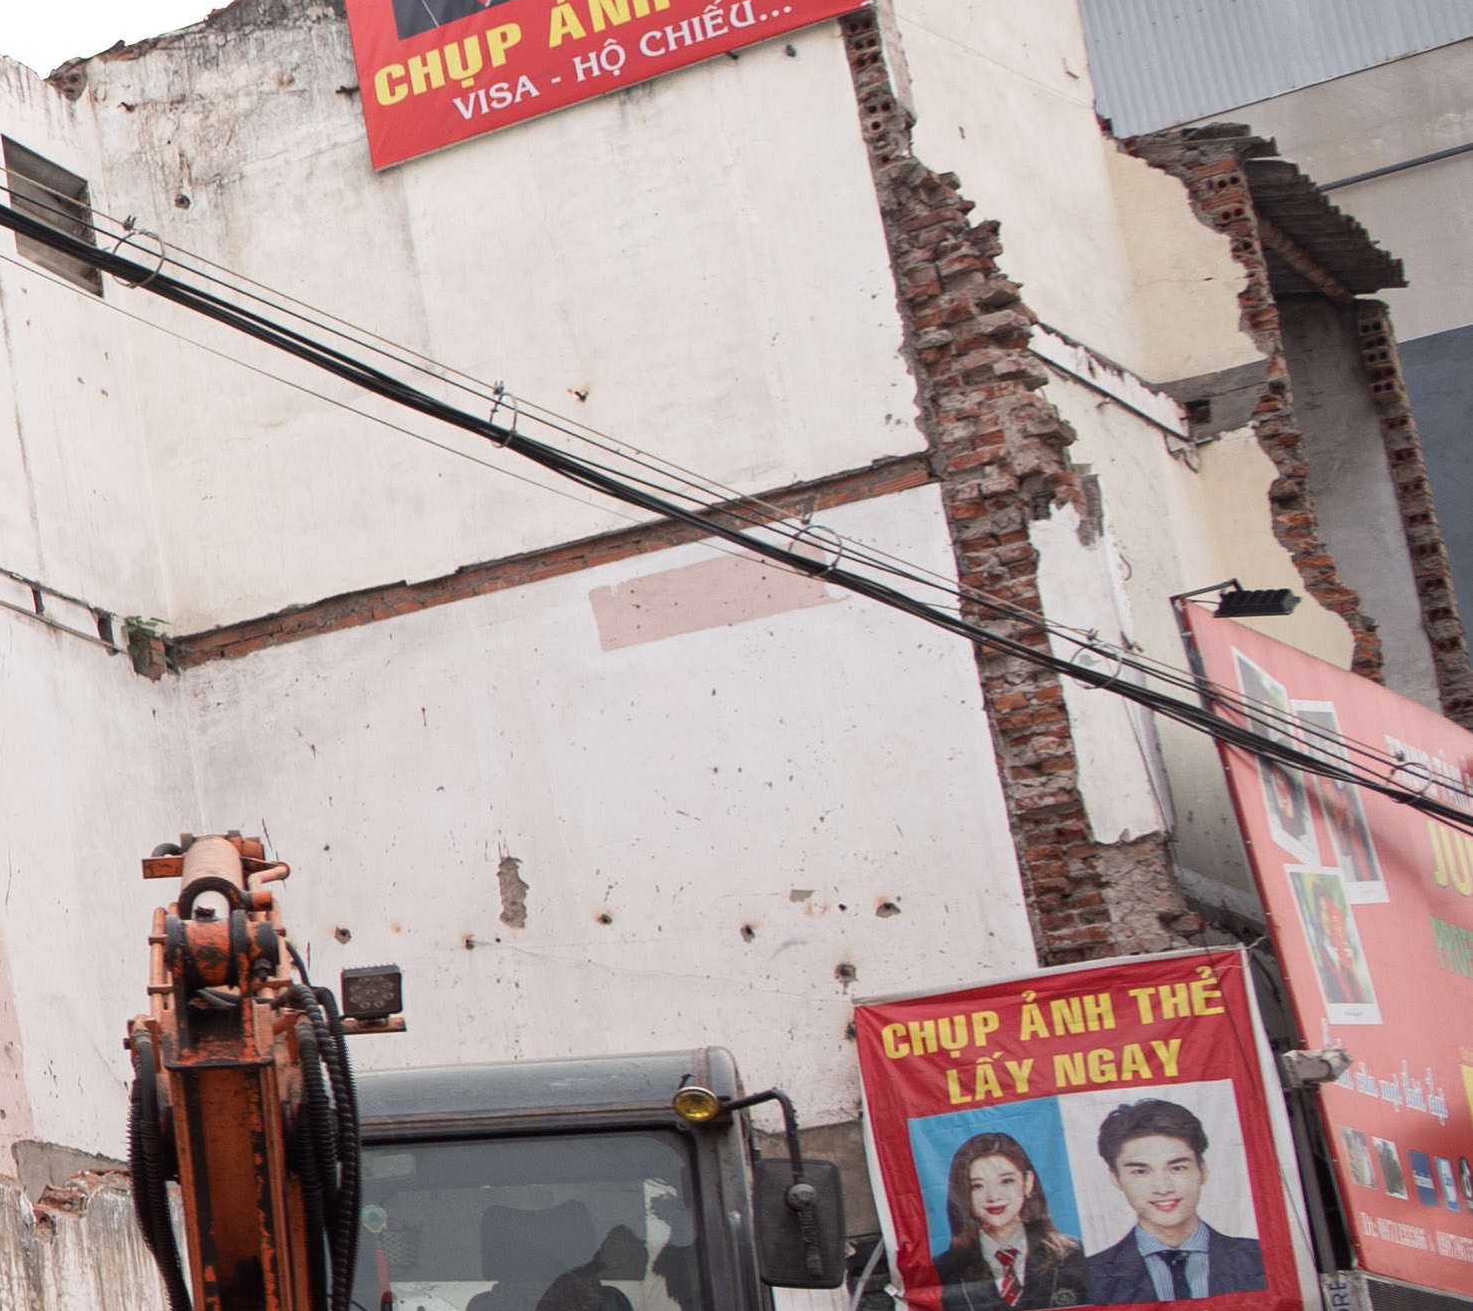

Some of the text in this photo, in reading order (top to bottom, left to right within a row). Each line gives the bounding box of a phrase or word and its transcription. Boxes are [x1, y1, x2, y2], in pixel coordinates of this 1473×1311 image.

[374, 21, 520, 105] CHỤP
[453, 74, 539, 120] VISA
[573, 38, 627, 81] HỘ
[882, 966, 1225, 1063] CHỤP ẢNH THẺ
[945, 1039, 1182, 1105] LẤY NGAY
